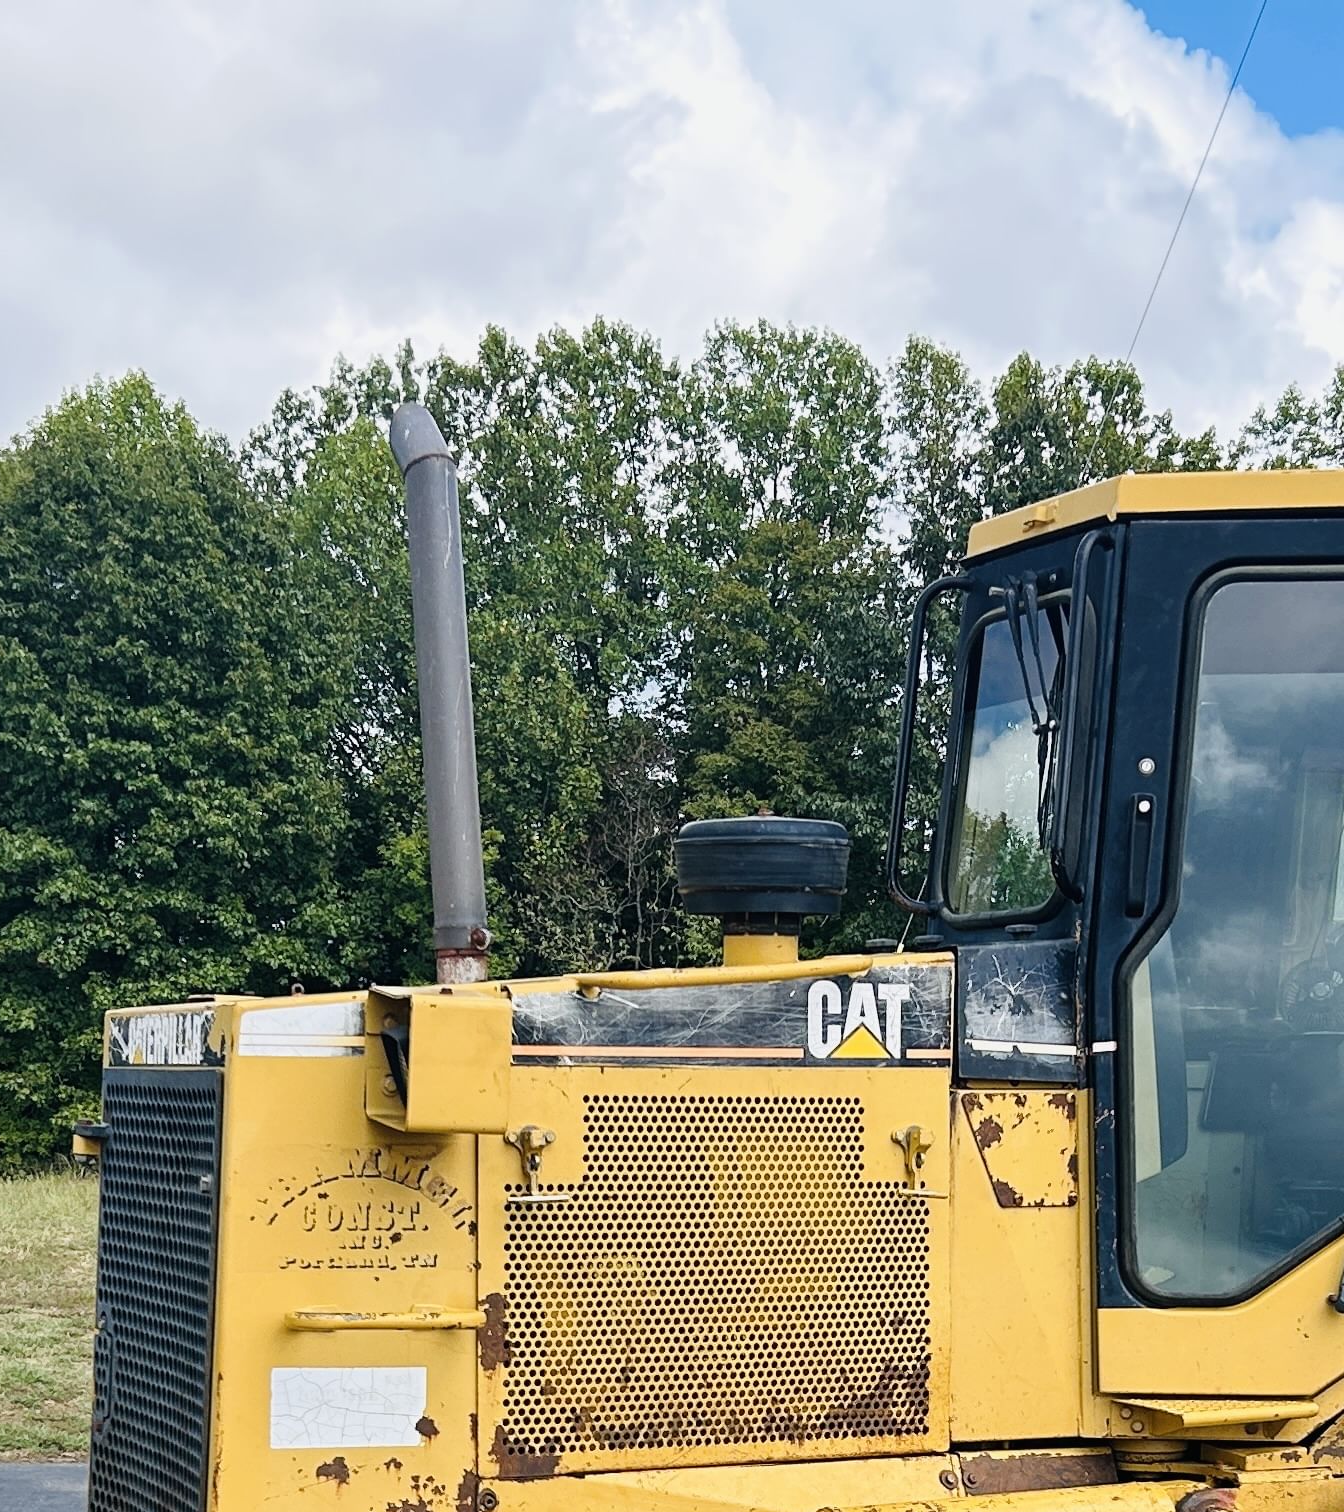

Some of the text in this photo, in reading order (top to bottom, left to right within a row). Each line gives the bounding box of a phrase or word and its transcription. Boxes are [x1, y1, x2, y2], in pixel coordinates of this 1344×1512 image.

[118, 1011, 204, 1065] ATERPILLAR
[807, 979, 911, 1060] CAT
[302, 1200, 429, 1232] CONST.
